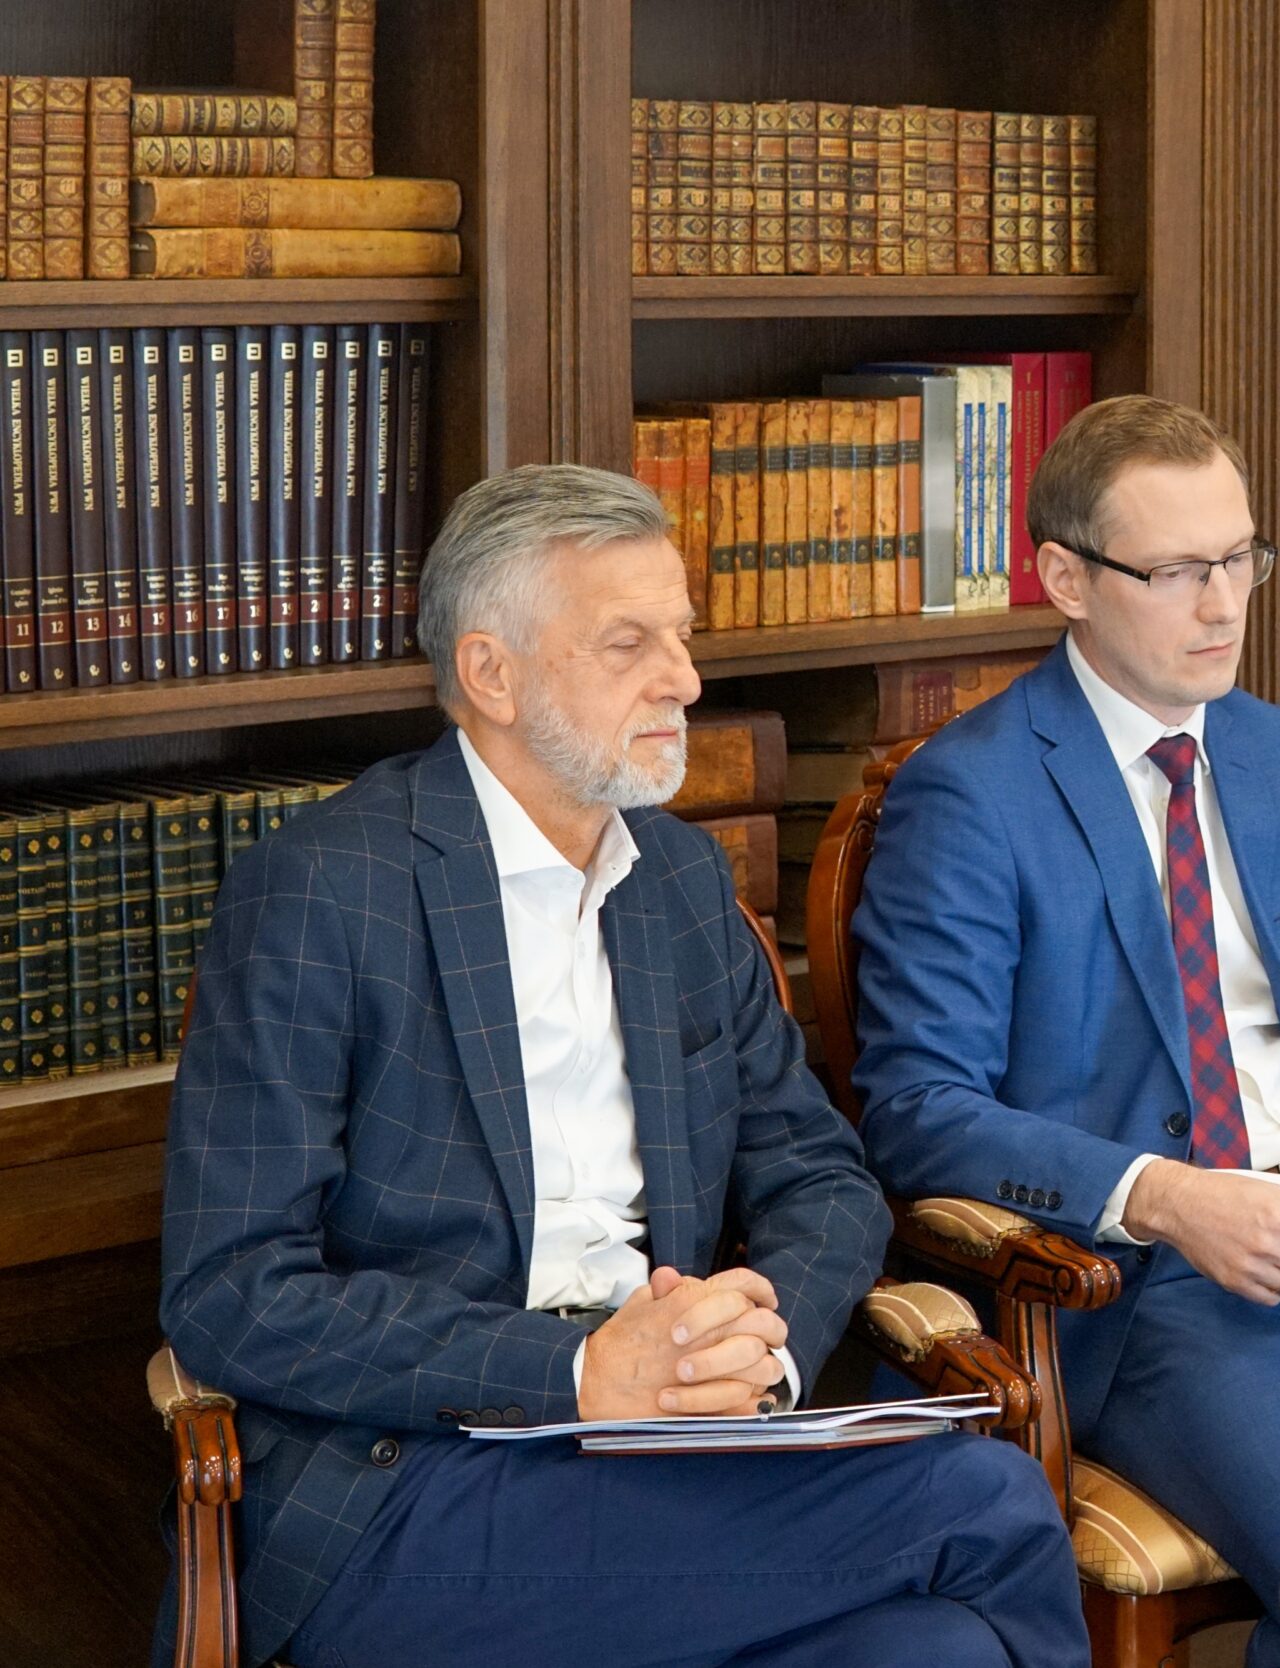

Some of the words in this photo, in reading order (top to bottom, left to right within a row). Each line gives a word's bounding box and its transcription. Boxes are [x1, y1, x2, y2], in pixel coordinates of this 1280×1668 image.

[11, 378, 22, 417] WIELKA
[47, 377, 57, 415] WIELKA
[80, 375, 91, 413] WIELKA
[113, 374, 123, 411] WIELKA
[147, 374, 158, 411] WIELKA
[181, 373, 192, 410] WIELKA
[215, 371, 225, 406] WIELKA
[250, 371, 259, 406] WIELKA
[283, 370, 294, 406] WIELKA
[315, 369, 325, 404] WIELKA
[348, 368, 357, 403] WIELKA
[380, 367, 389, 401] WIELKA
[11, 418, 24, 490] ENCYKLOPEDIA
[47, 417, 59, 489] ENCYKLOPEDIA
[81, 415, 93, 486] ENCYKLOPEDIA
[113, 413, 125, 484] ENCYKLOPEDIA
[148, 413, 159, 482] ENCYKLOPEDIA
[182, 412, 194, 481] ENCYKLOPEDIA
[215, 409, 227, 478] ENCYKLOPEDIA
[250, 408, 260, 476] ENCYKLOPEDIA
[283, 408, 293, 476] ENCYKLOPEDIA
[314, 406, 324, 474] ENCYKLOPEDIA
[347, 406, 356, 472] ENCYKLOPEDIA
[379, 403, 388, 470] ENCYKLOPEDIA
[83, 487, 95, 511] PWN
[116, 485, 126, 509] PWN
[150, 484, 160, 508] PWN
[184, 483, 194, 506] PWN
[218, 480, 227, 503] PWN
[250, 479, 260, 501] PWN
[284, 478, 293, 500] PWN
[314, 476, 323, 498] PWN
[346, 474, 355, 497] PWN
[379, 473, 387, 495] PWN
[13, 492, 25, 516] PWN
[48, 490, 59, 514] PWN
[17, 624, 29, 637] 11
[51, 621, 64, 634] 12
[86, 618, 100, 632] 13
[118, 613, 132, 628] 14
[152, 612, 165, 626] 15
[185, 609, 199, 623] 16
[217, 607, 230, 620] 17
